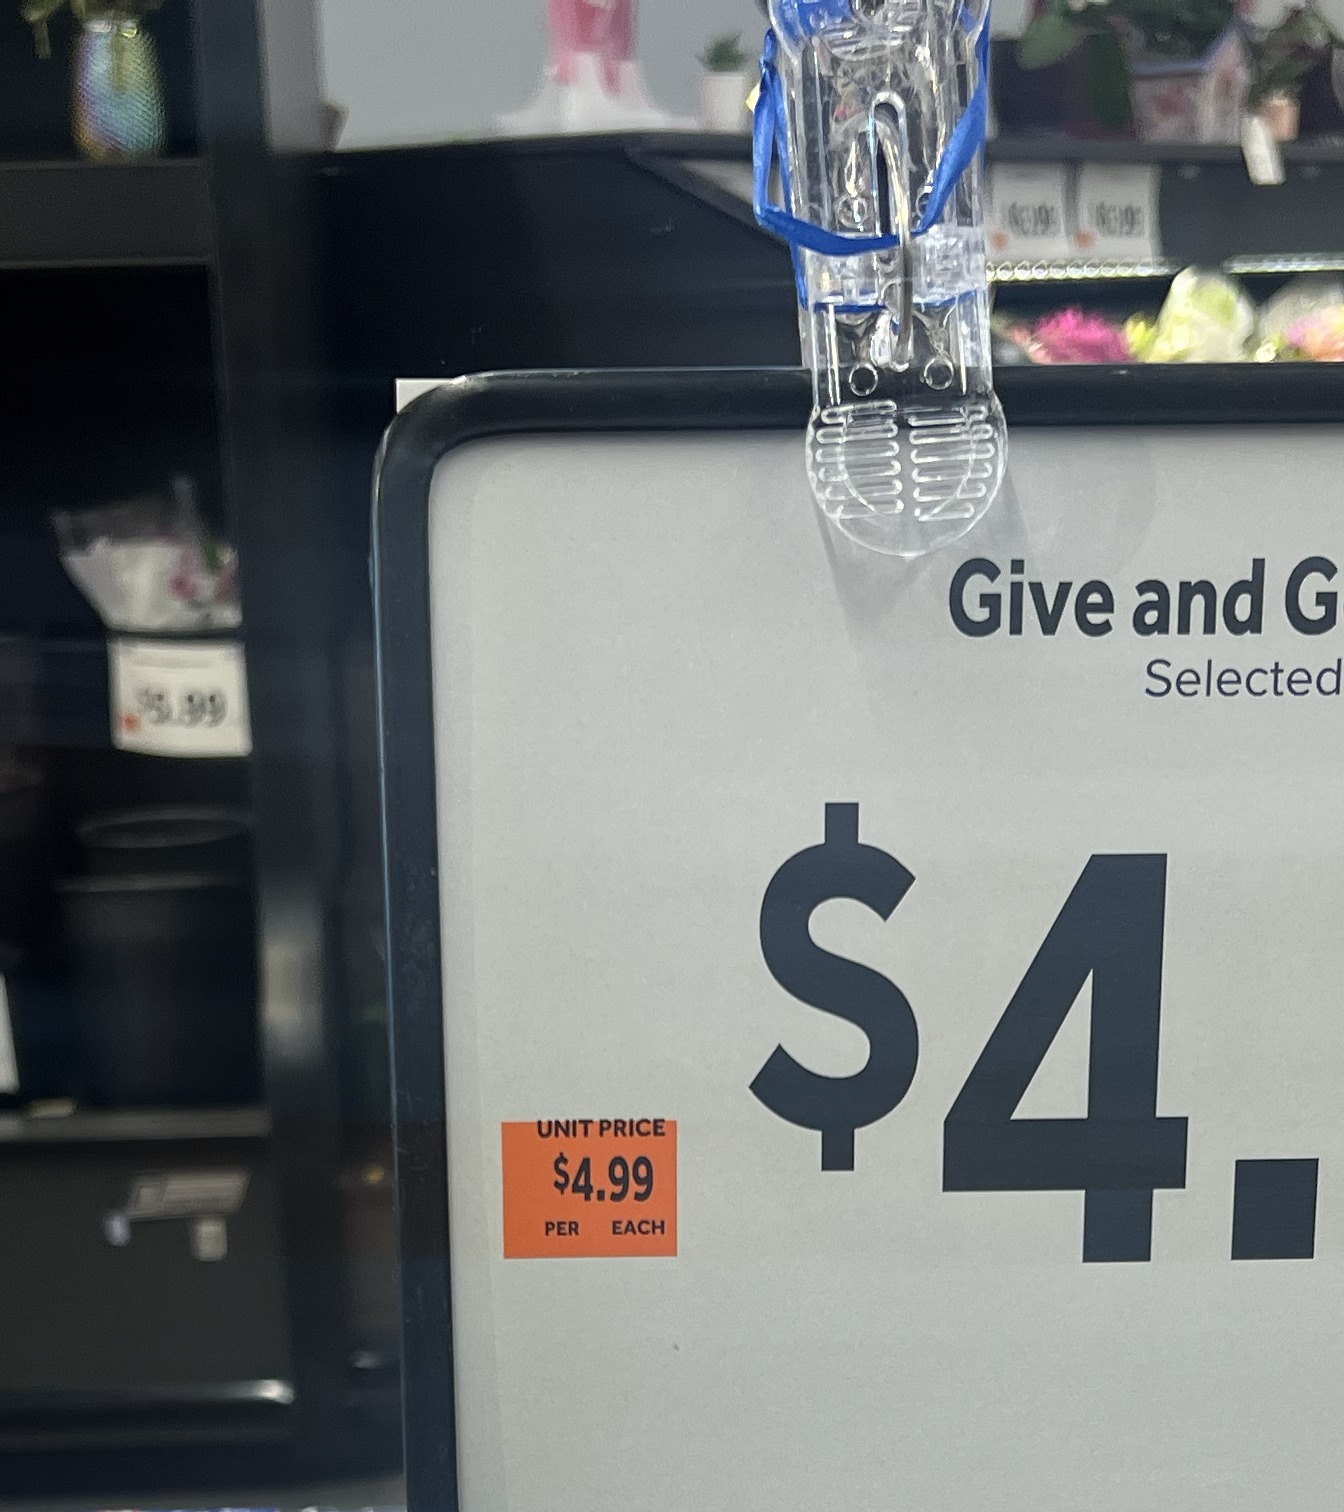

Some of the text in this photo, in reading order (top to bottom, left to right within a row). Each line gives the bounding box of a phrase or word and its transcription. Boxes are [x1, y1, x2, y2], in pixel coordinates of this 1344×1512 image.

[949, 556, 1115, 638] Give
[1132, 557, 1266, 637] and
[1145, 657, 1343, 699] Selected
[536, 1118, 666, 1139] UNIT PRICE
[553, 1151, 654, 1203] $4.99
[544, 1219, 666, 1237] PER EACH
